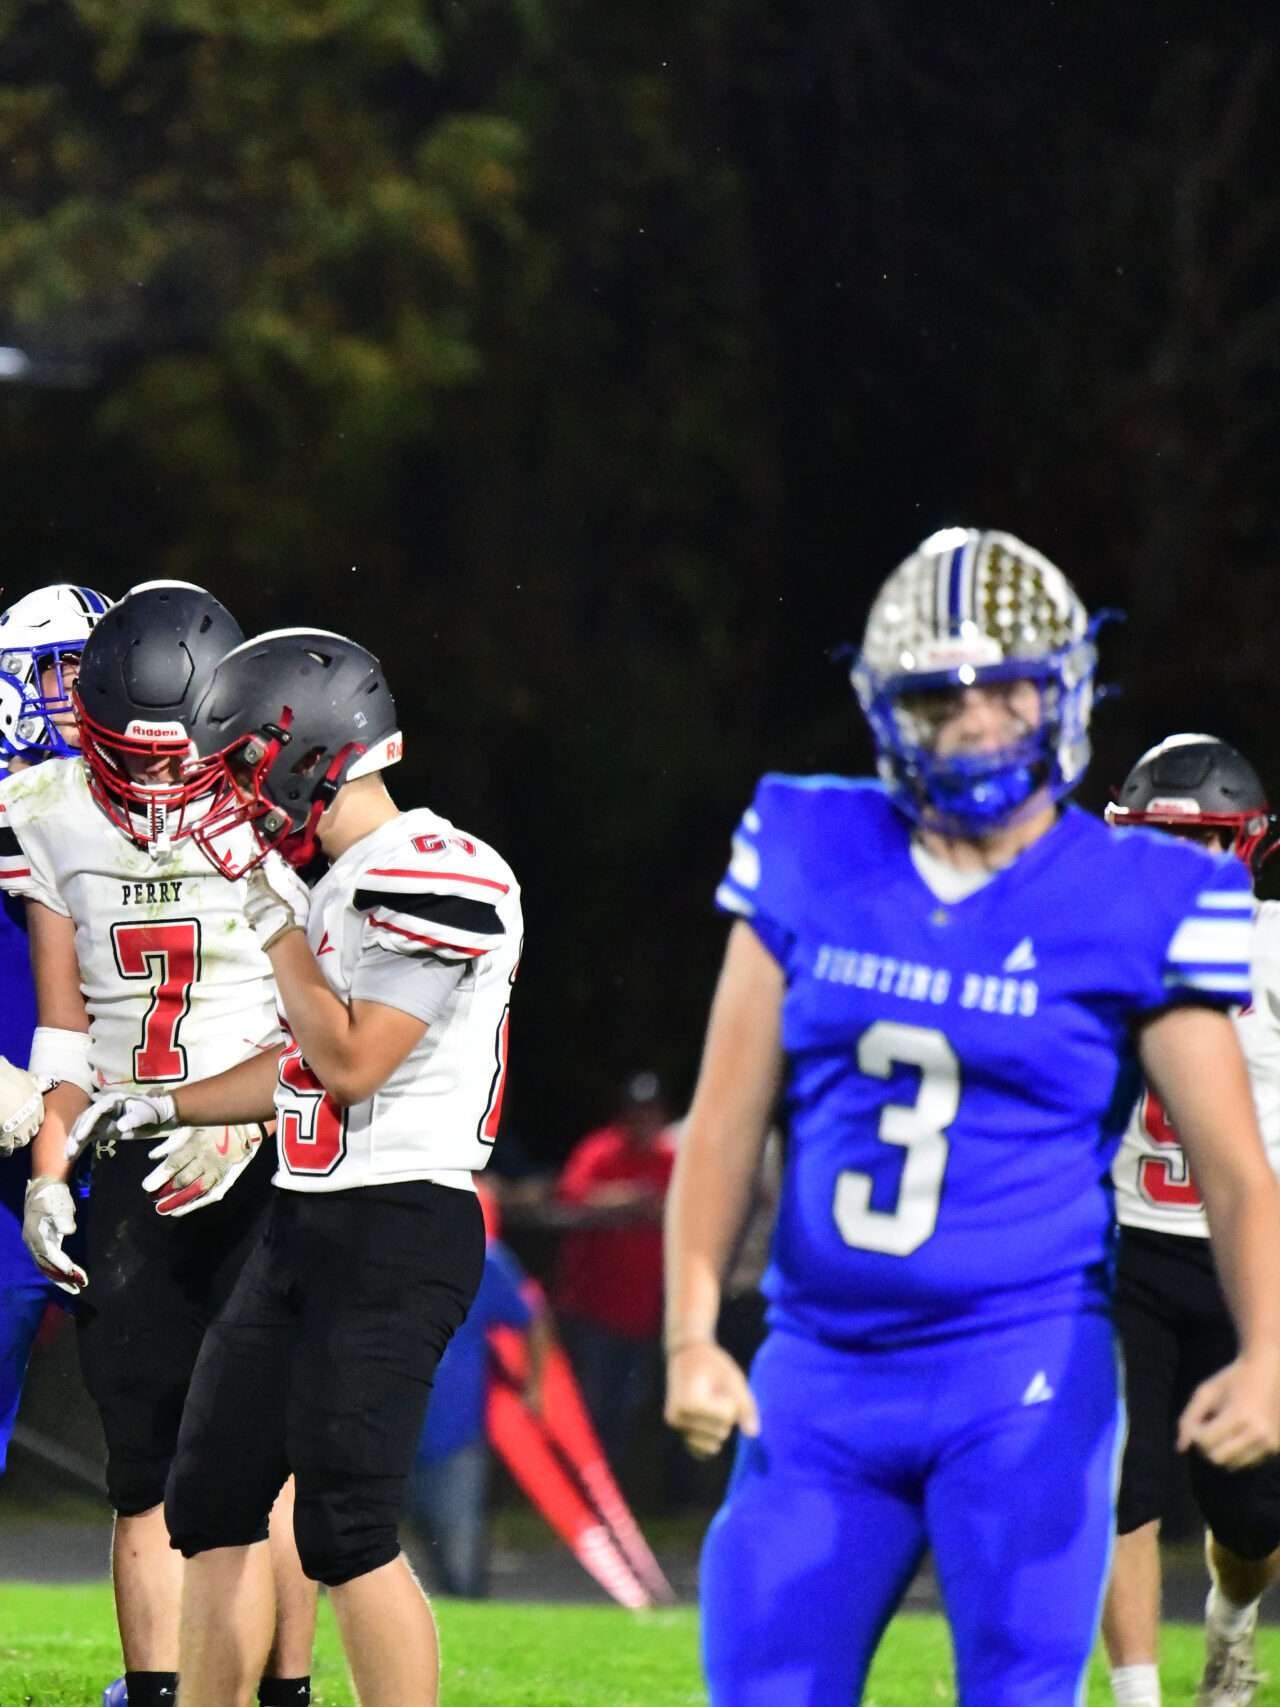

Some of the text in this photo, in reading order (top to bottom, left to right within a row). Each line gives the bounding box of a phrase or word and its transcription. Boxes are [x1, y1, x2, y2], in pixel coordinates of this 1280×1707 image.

[122, 881, 183, 905] PERRY
[110, 917, 202, 1084] 7
[833, 1020, 961, 1258] 3
